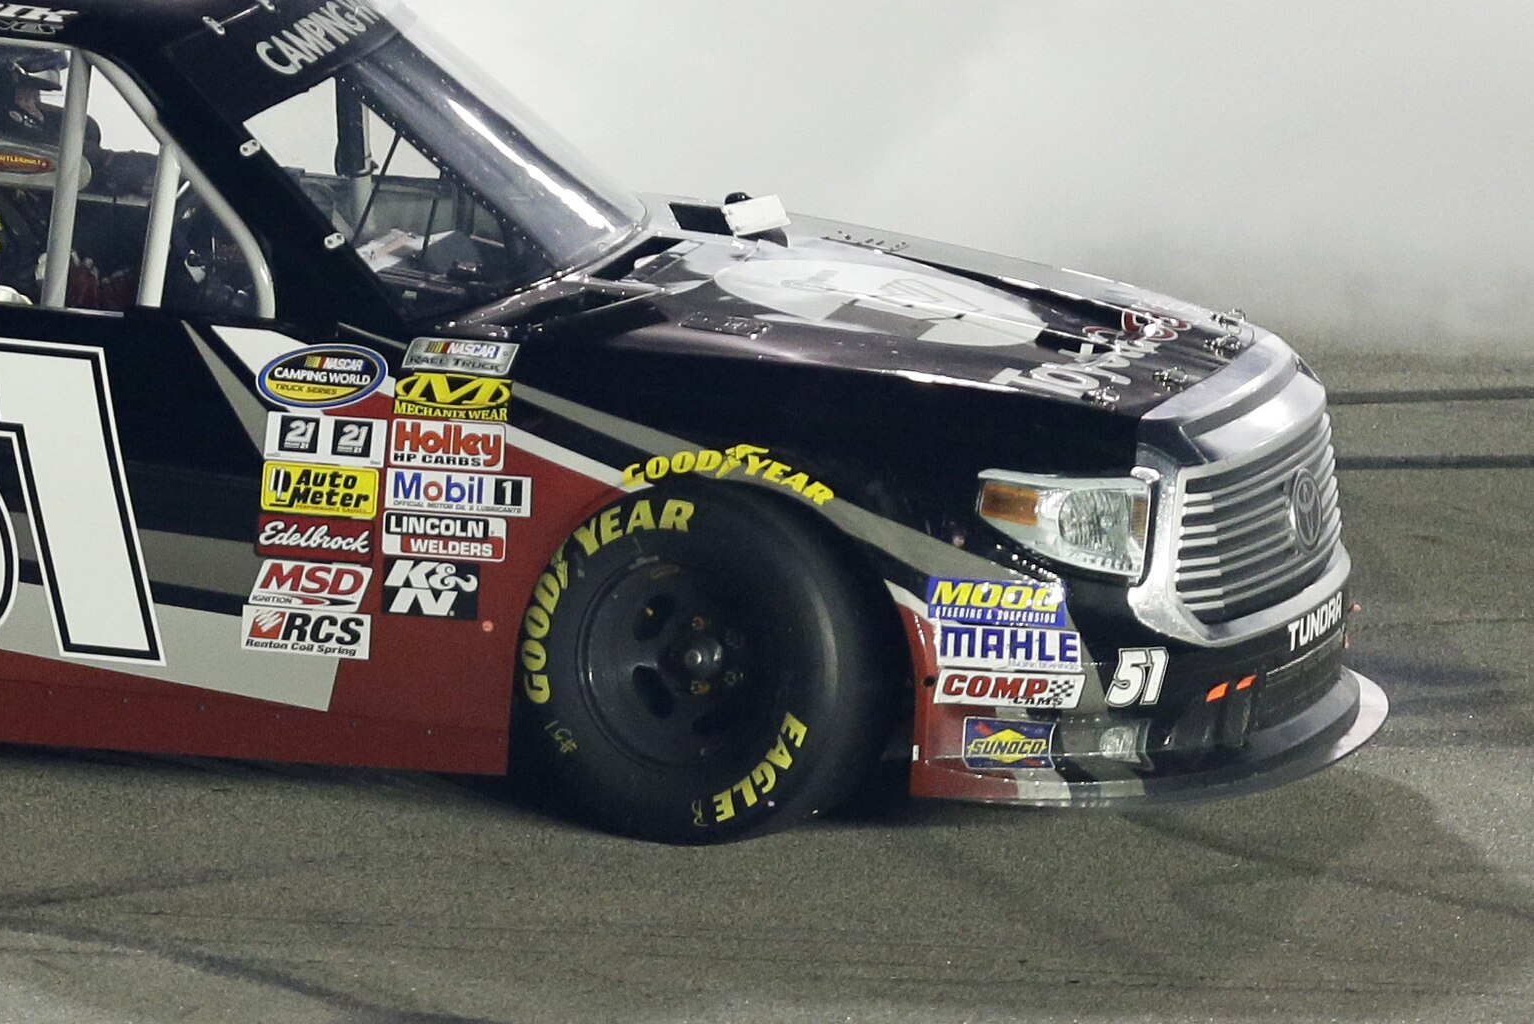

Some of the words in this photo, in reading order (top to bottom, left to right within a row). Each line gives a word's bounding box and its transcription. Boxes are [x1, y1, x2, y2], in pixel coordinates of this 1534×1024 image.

[255, 0, 367, 75] CAMPING
[447, 341, 497, 359] NASCAR
[322, 357, 364, 371] NASCAR
[453, 358, 501, 372] TRUCK
[274, 367, 327, 383] CAMPING
[329, 372, 371, 385] WORLD
[276, 383, 303, 392] TRUCK
[306, 386, 338, 395] SERIES
[393, 400, 467, 419] MECHANIX
[468, 407, 508, 422] WEAR
[285, 419, 317, 443] 21
[337, 423, 369, 447] 21
[395, 421, 502, 467] Holley
[393, 453, 417, 463] HP
[422, 454, 481, 466] CARBS
[295, 469, 358, 489] Auto
[393, 471, 484, 504] Mobil
[289, 486, 370, 508] Meter
[259, 520, 370, 554] Edelbrock
[389, 515, 484, 538] LINCOLN
[410, 538, 493, 556] WELDERS
[259, 562, 364, 596] MSD
[251, 595, 294, 604] IGNITION
[935, 606, 983, 621] STEERING
[997, 609, 1057, 624] SUSPENSION
[1288, 591, 1343, 652] TUNDRA
[281, 612, 364, 646] RCS
[245, 638, 288, 649] Renton
[291, 642, 314, 652] Coil
[316, 644, 357, 657] Spring
[940, 626, 1078, 663] MAHLE
[942, 674, 1049, 699] COMP
[1105, 646, 1169, 707] 51
[1013, 695, 1064, 707] CAMS
[970, 739, 1046, 756] SUNOCO
[712, 711, 808, 823] EAGLE
